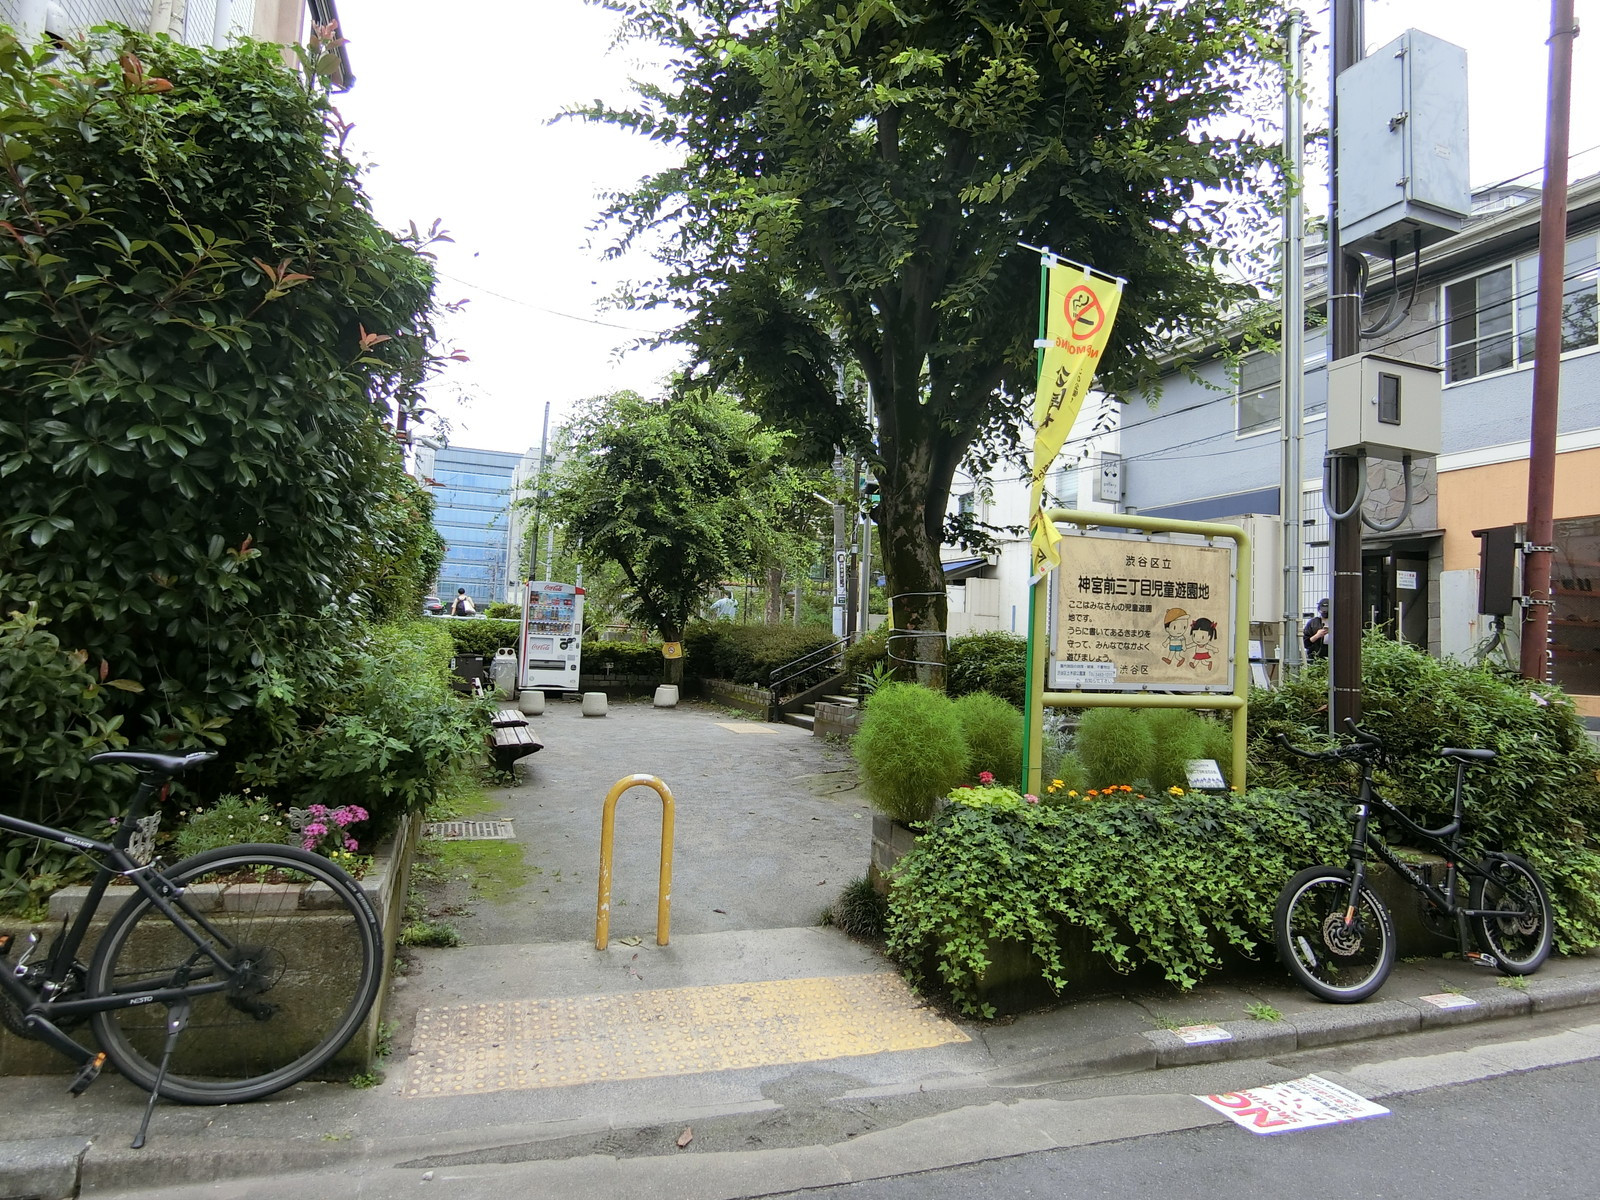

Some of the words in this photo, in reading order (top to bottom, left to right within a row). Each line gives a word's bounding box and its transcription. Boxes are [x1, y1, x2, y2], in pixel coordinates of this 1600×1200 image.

[1125, 555, 1172, 570] 渋谷区立
[1077, 574, 1211, 600] 神宮前三丁目児童遊園地
[1068, 600, 1153, 613] ここはみなさんの児童遊園
[1067, 613, 1093, 623] 地です。
[1067, 626, 1151, 638] うらに書いてあるきまりを
[1066, 639, 1150, 651] 守って、みんなでなかよく
[1066, 652, 1113, 663] 遊びましょう。
[1119, 664, 1149, 675] 渋谷区
[129, 995, 154, 1005] NESTO
